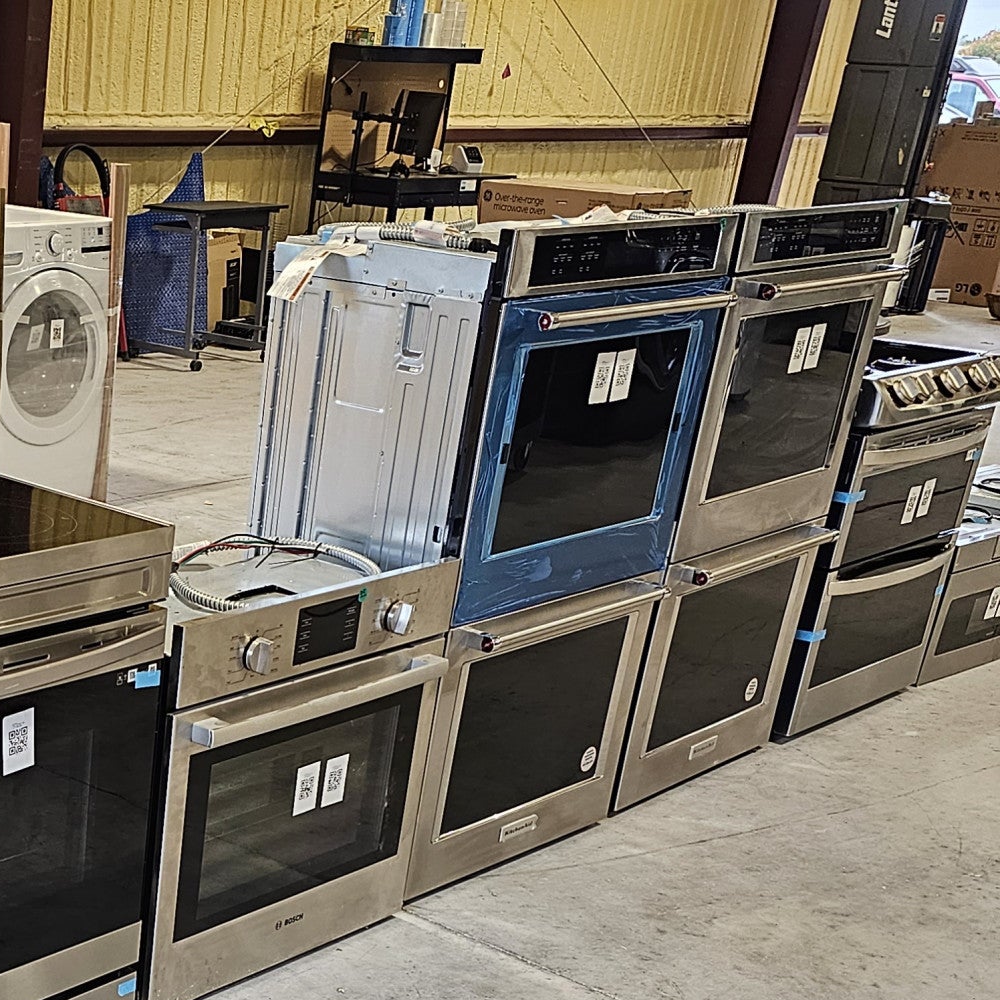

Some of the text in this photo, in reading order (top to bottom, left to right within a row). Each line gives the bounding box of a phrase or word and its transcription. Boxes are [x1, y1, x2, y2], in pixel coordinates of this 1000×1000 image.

[494, 192, 545, 207] Over-the-range
[493, 203, 546, 215] microwave oven
[955, 283, 969, 293] LG
[284, 912, 304, 926] BOSCH
